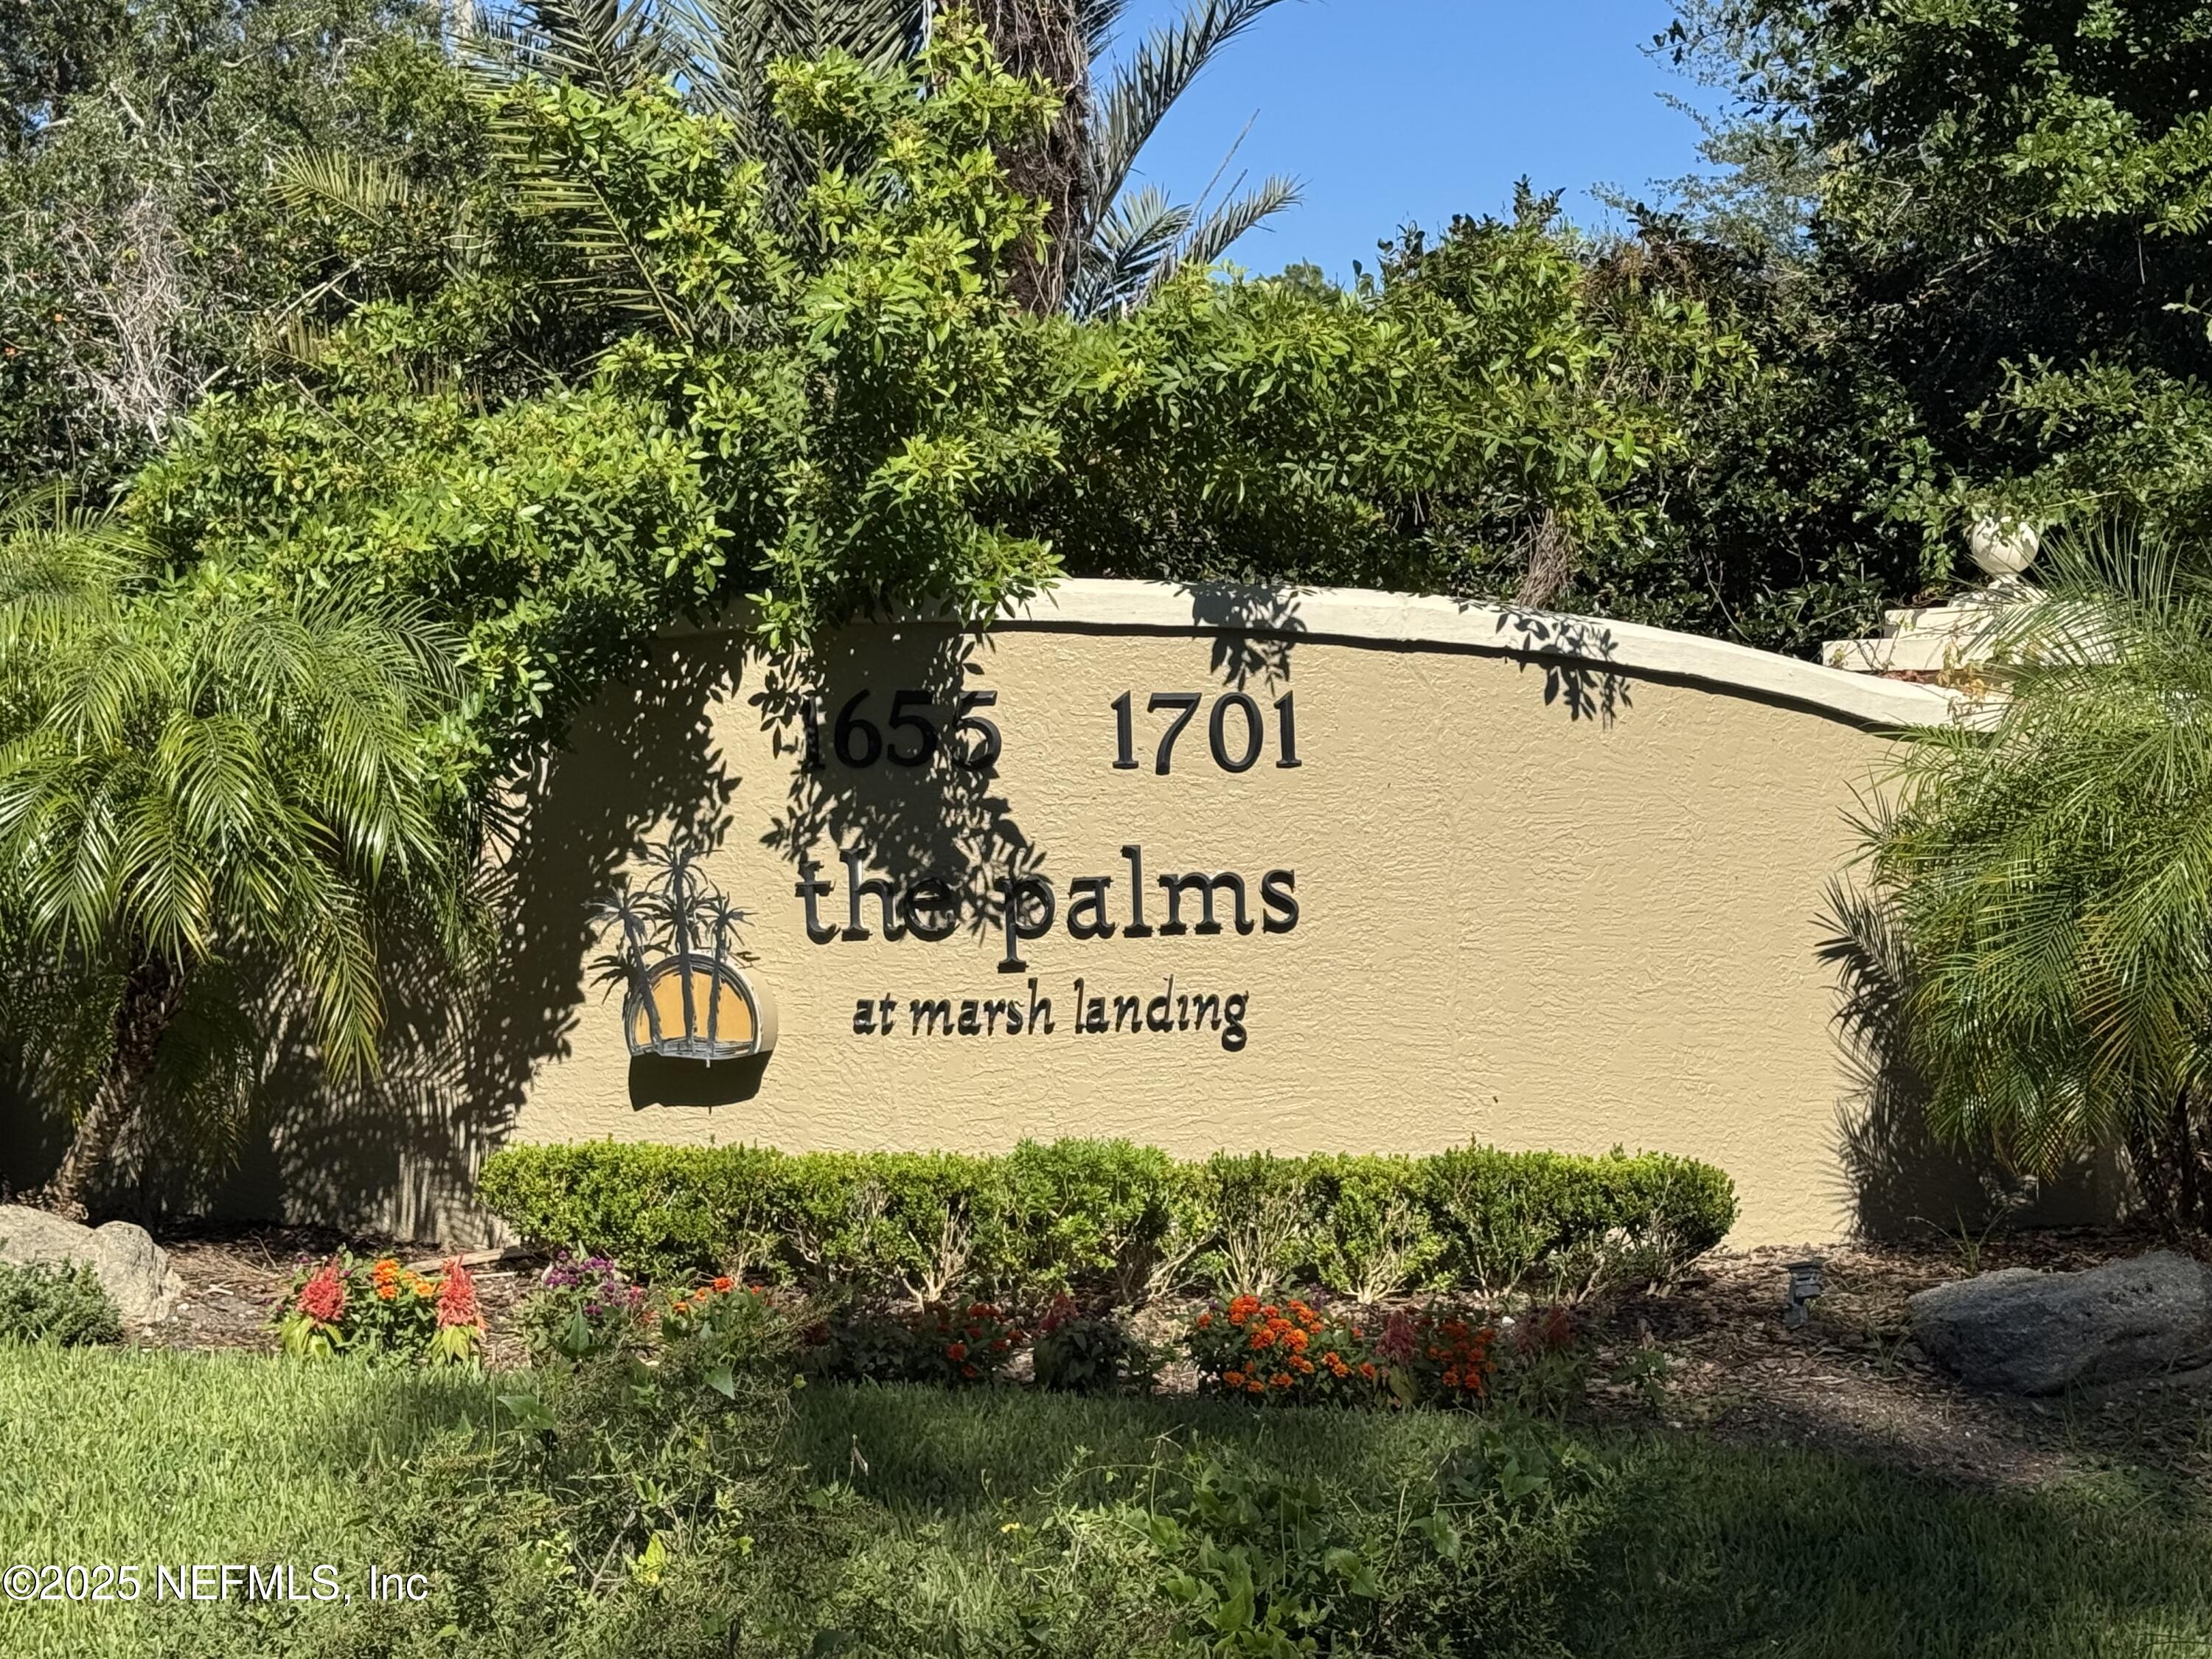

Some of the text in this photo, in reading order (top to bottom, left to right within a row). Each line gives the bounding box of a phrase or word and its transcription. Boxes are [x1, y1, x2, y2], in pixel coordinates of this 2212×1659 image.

[800, 689, 1302, 775] 1655 1701
[795, 845, 1299, 973] the palms
[853, 974, 1249, 1052] at marsh landing
